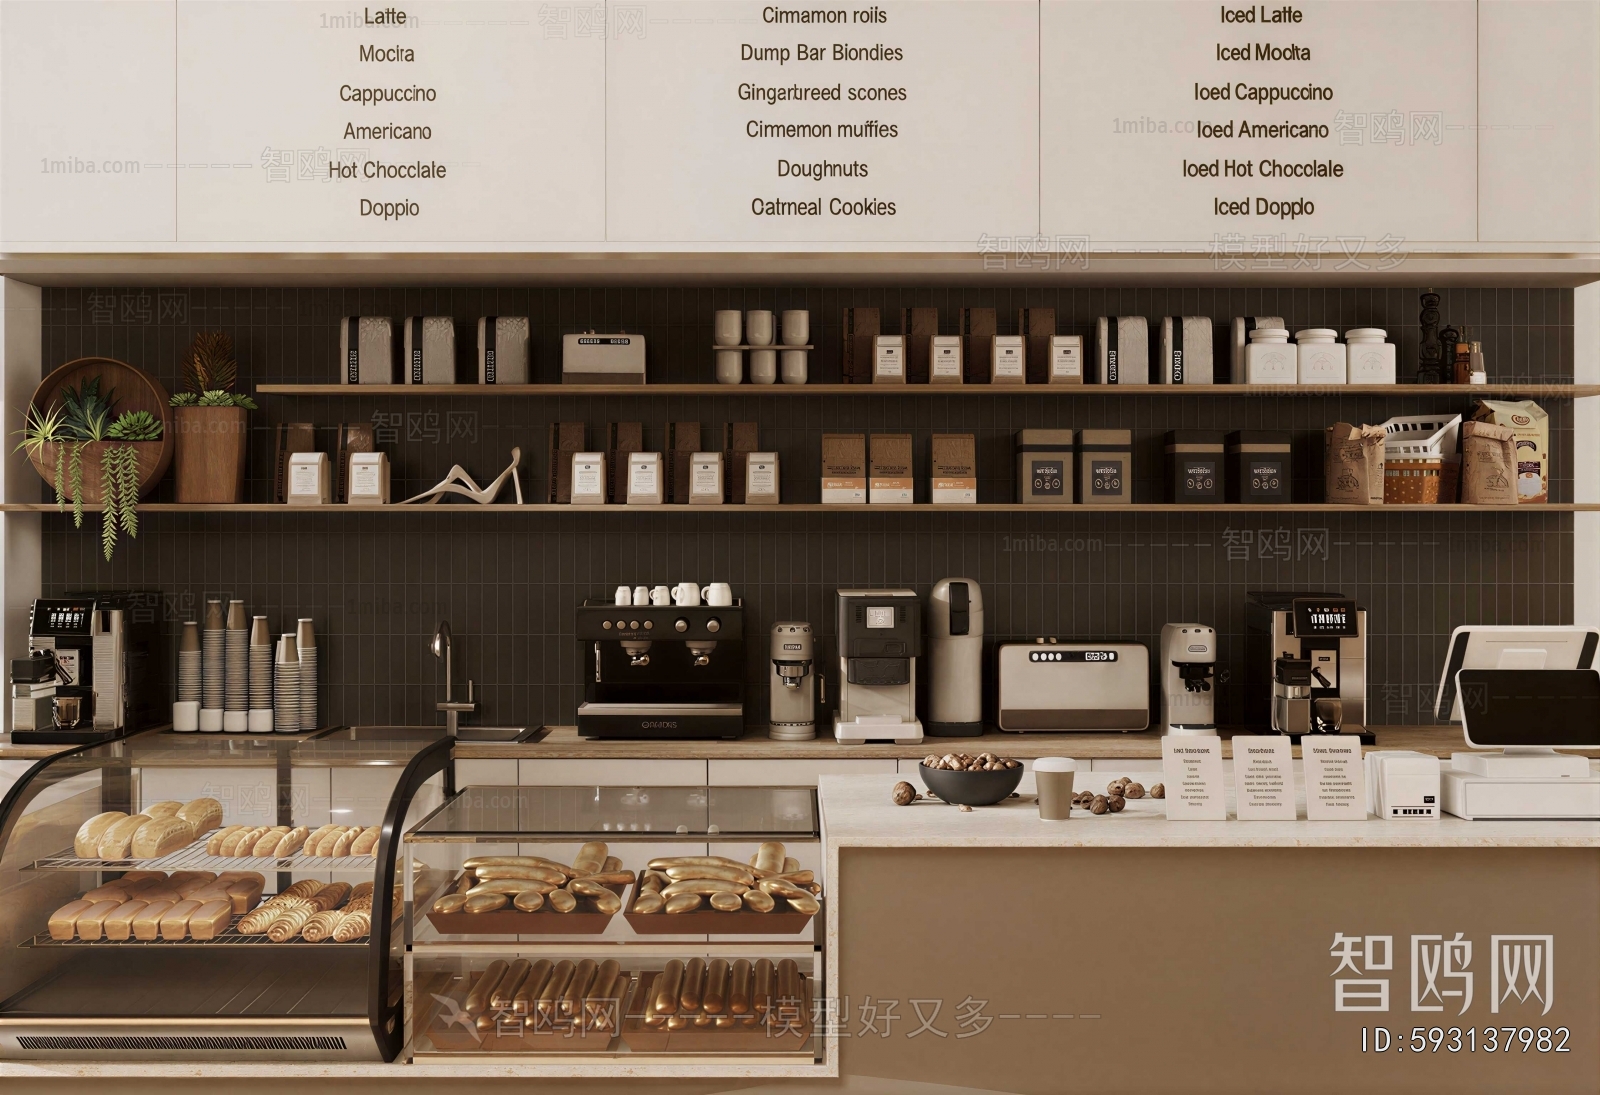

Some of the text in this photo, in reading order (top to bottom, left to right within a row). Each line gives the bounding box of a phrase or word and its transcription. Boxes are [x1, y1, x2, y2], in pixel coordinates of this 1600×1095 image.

[364, 7, 407, 25] Latte
[1221, 5, 1303, 24] Iced Latte
[741, 43, 791, 66] Dump
[797, 43, 827, 61] Bar
[1216, 42, 1251, 62] Iced
[339, 84, 437, 107] Cappuccino
[847, 87, 907, 101] scones
[343, 121, 432, 140] Americano
[1237, 120, 1330, 139] Americano
[329, 160, 358, 179] Hot
[778, 159, 869, 182] Doughnuts
[1224, 159, 1254, 178] Hot
[360, 198, 420, 221] Doppio
[829, 197, 897, 216] Cookies
[1214, 196, 1250, 216] Iced
